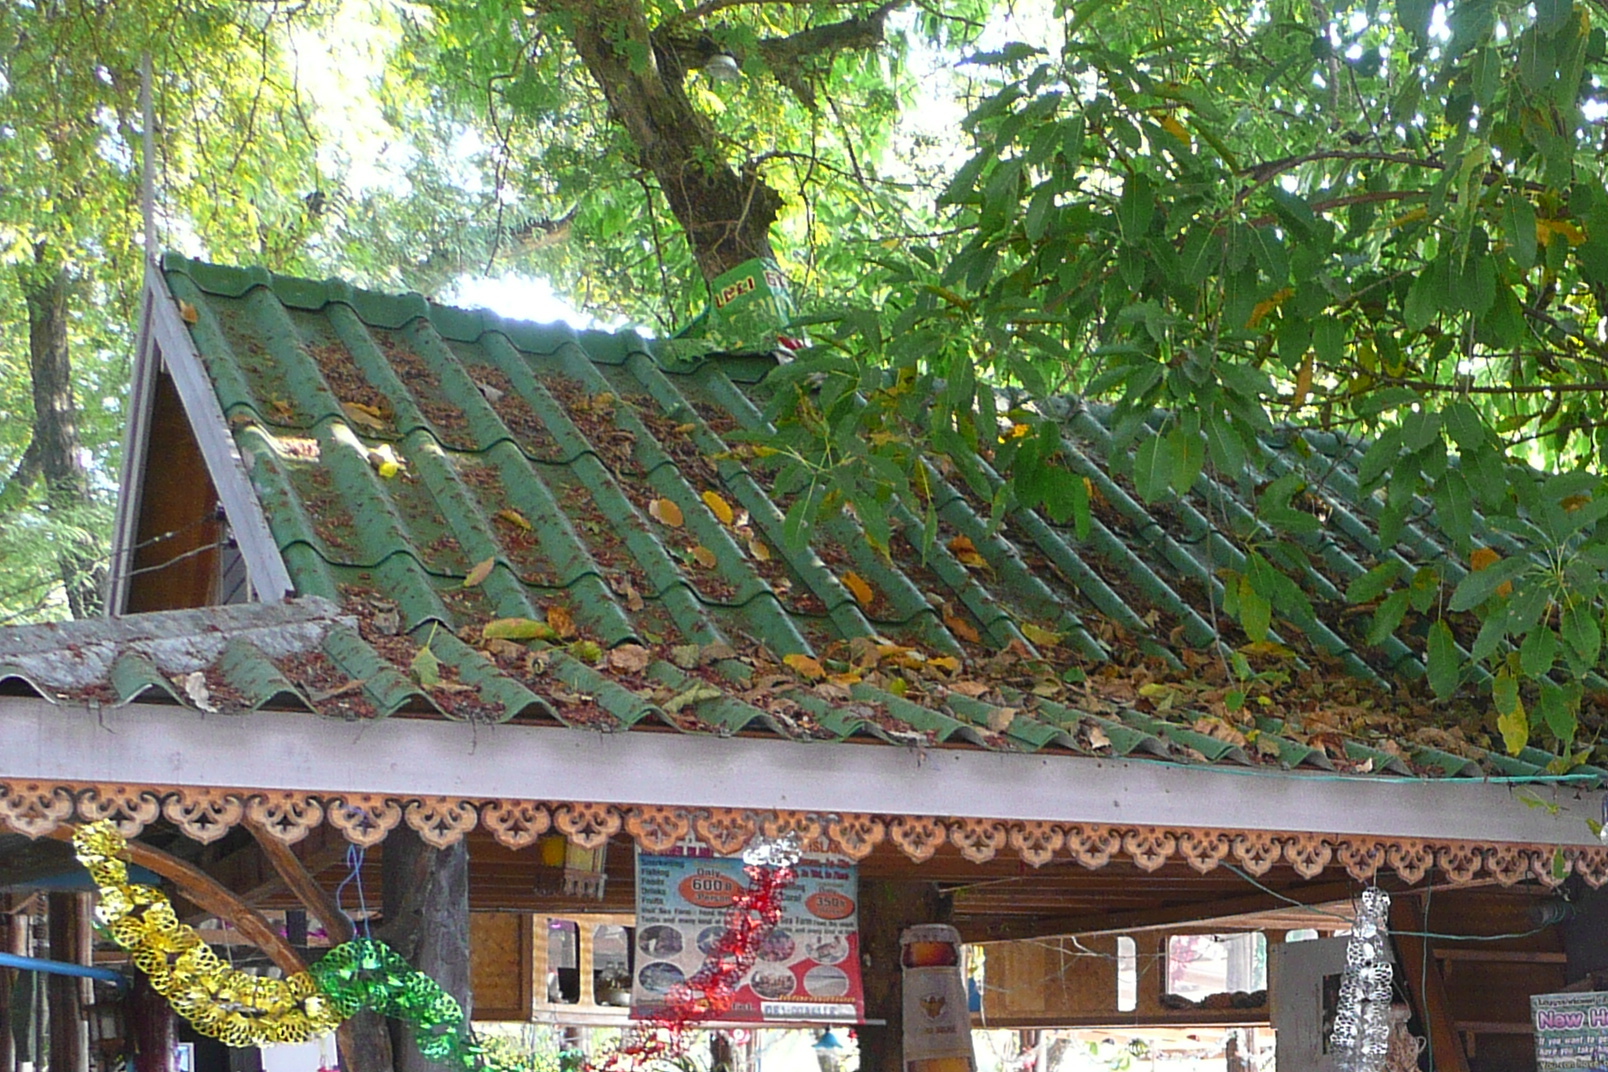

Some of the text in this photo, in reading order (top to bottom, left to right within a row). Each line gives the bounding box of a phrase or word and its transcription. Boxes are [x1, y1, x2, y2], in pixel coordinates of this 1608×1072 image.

[692, 879, 722, 891] 600
[1537, 1009, 1584, 1031] New
[1548, 1037, 1561, 1046] you
[1564, 1036, 1583, 1044] want
[1587, 1035, 1595, 1043] to
